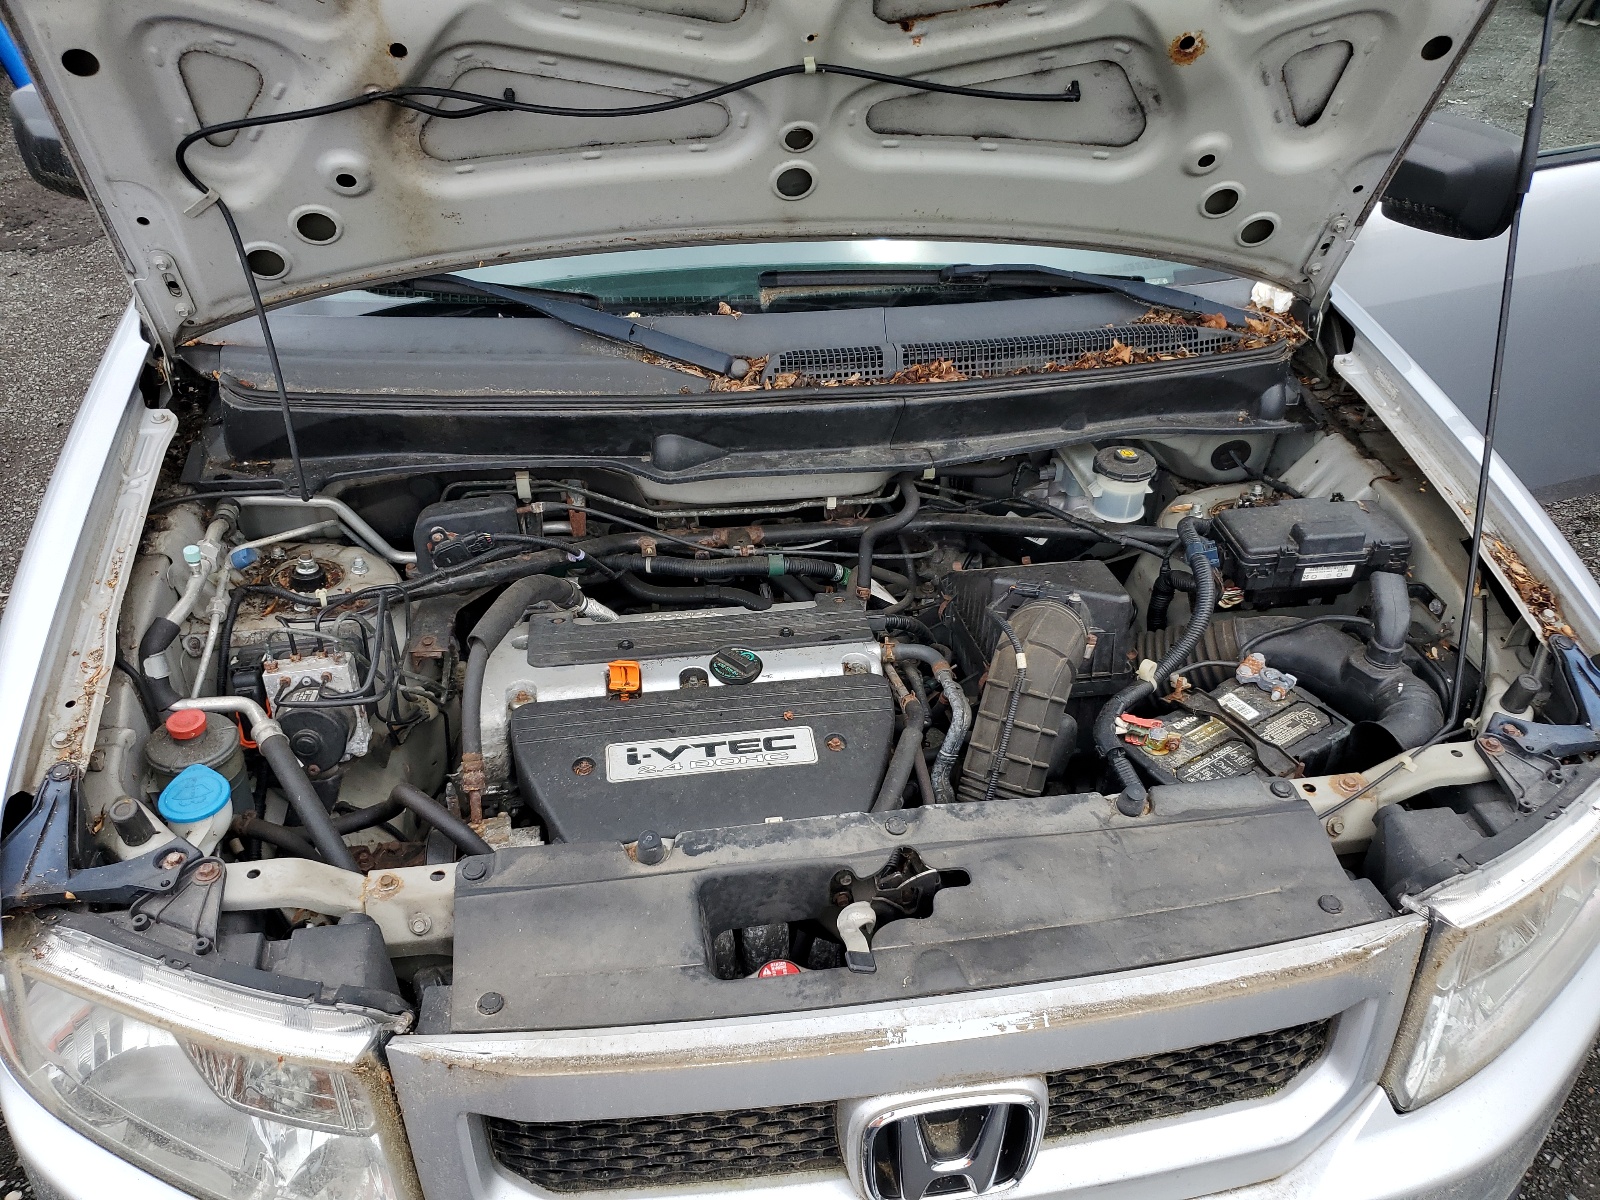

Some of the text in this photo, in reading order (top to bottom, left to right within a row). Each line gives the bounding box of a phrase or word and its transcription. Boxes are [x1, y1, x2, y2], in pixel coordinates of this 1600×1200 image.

[626, 734, 797, 766] i-VTEC
[638, 752, 789, 775] 2.4 DOHC
